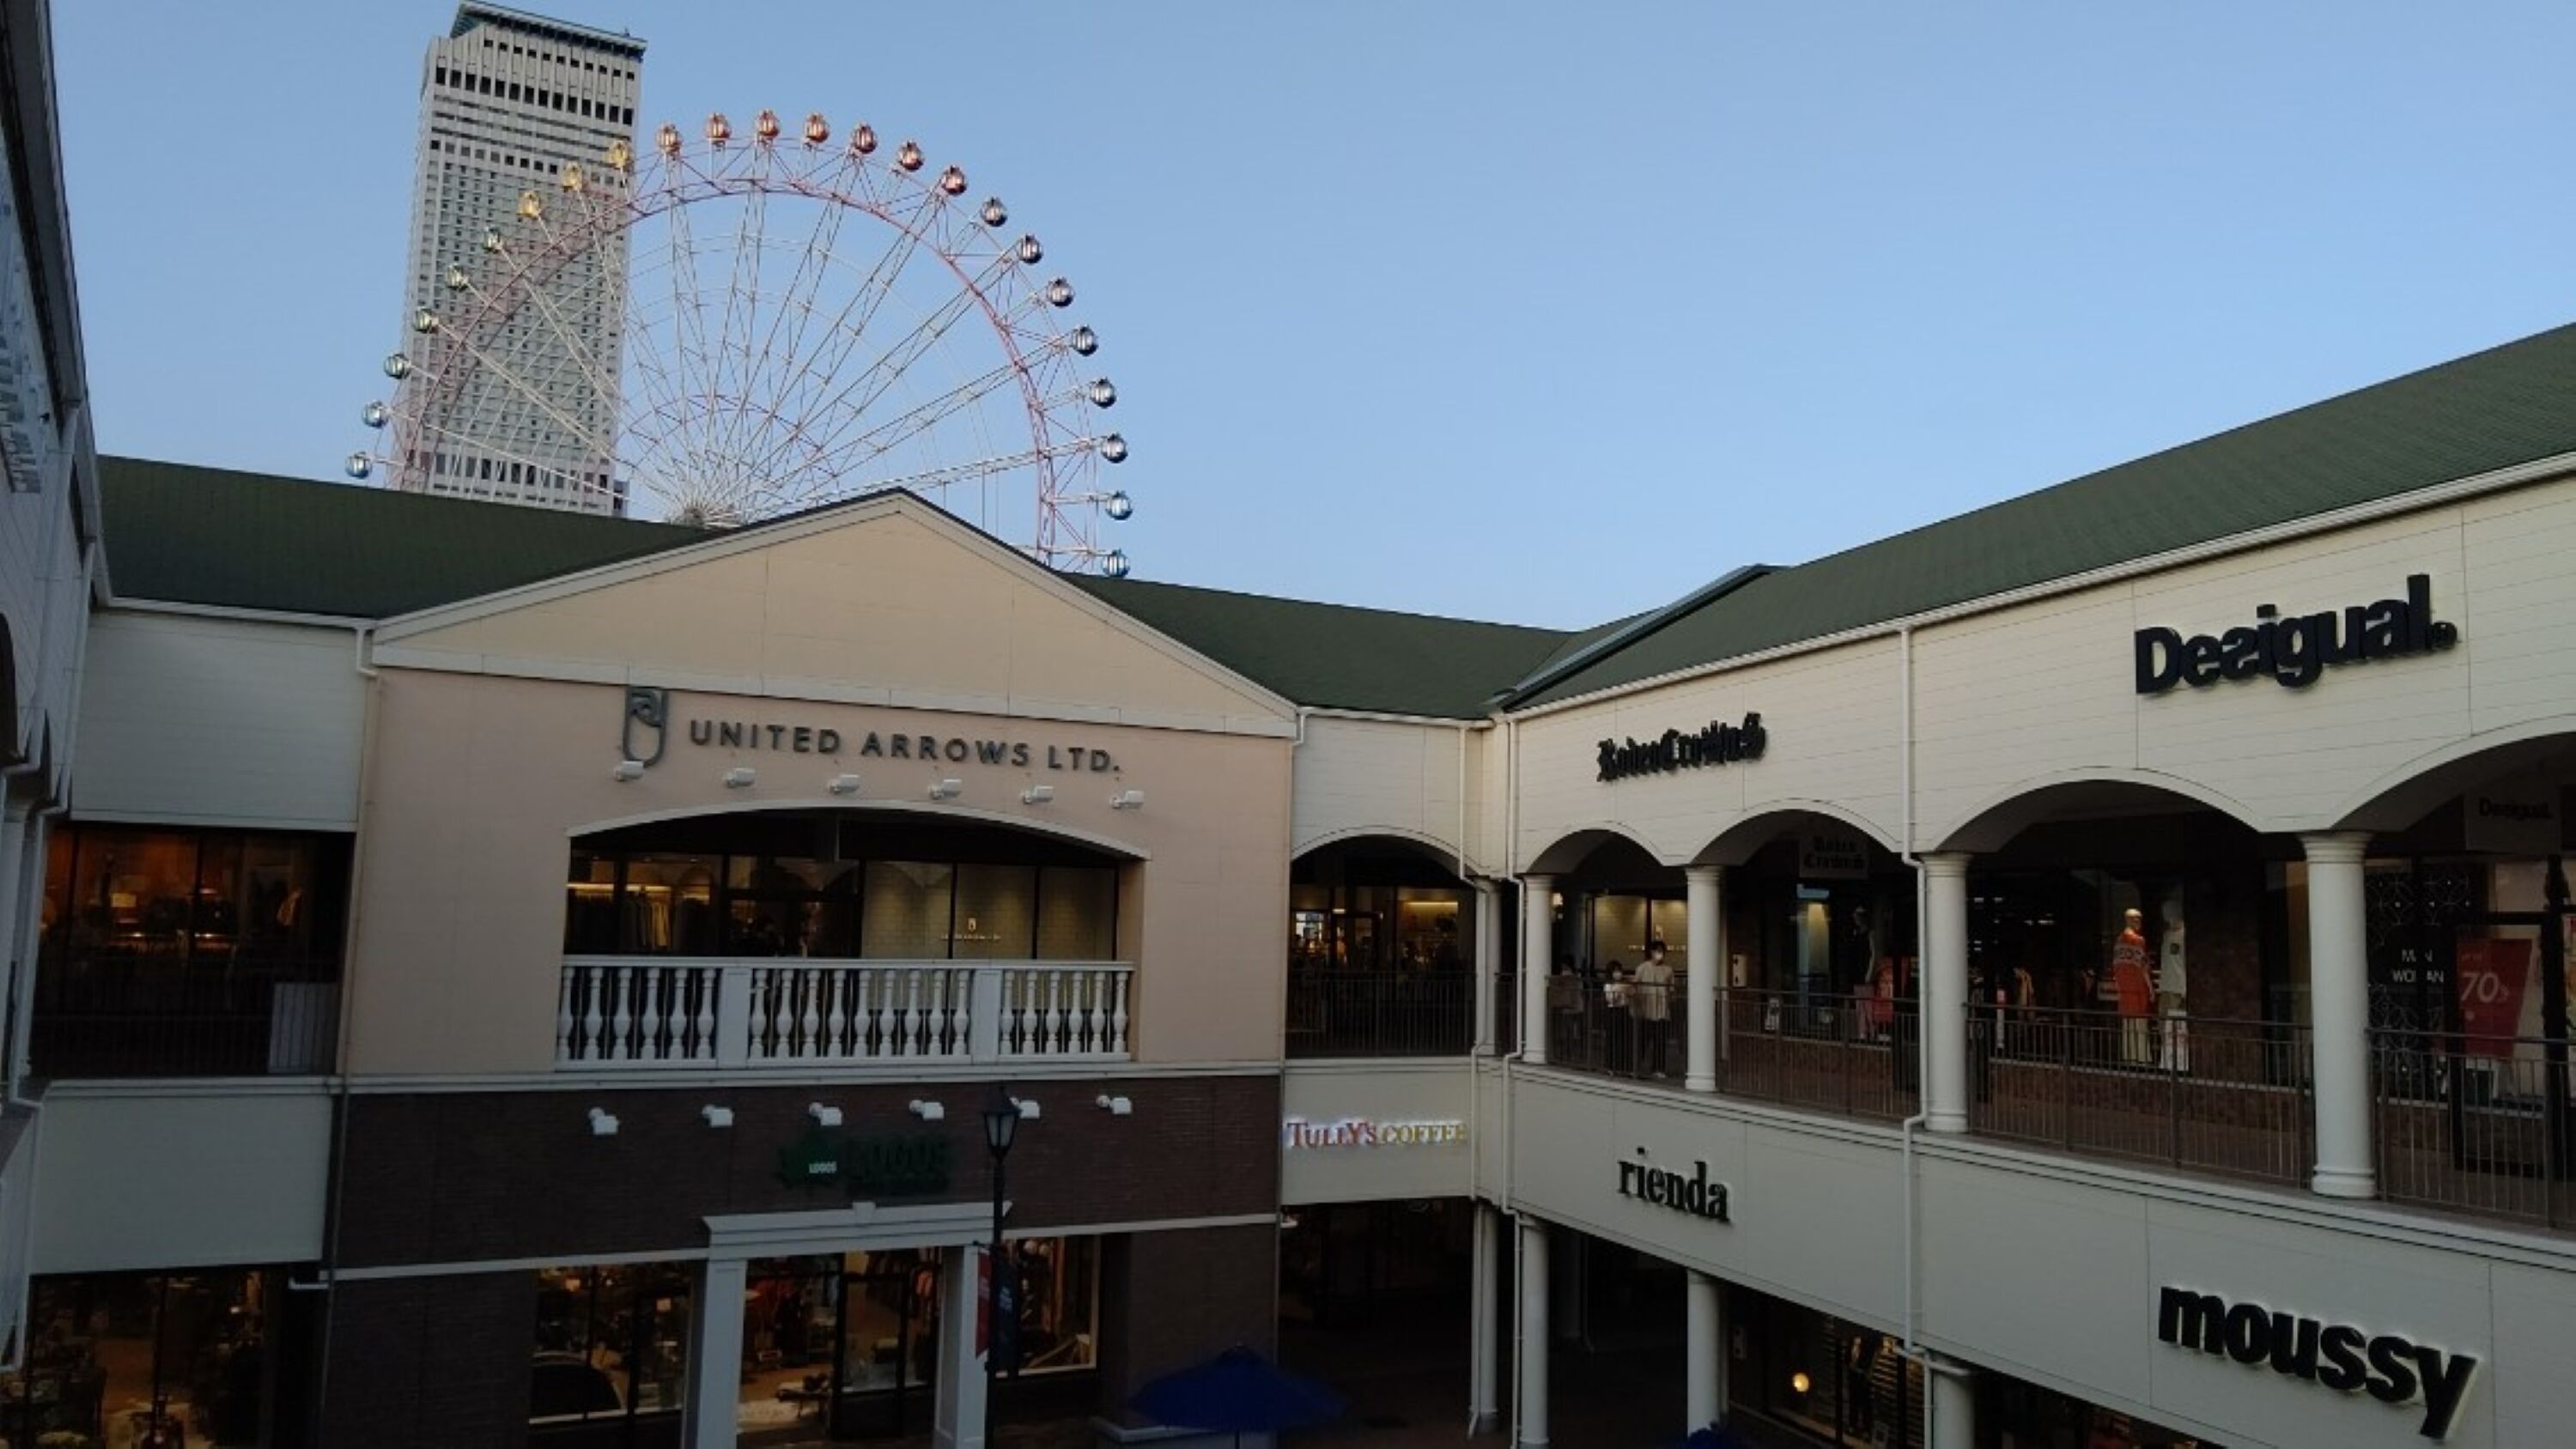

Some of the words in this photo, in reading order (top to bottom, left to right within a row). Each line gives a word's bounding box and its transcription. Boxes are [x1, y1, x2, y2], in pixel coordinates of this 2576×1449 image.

[690, 719, 841, 753] UNITED
[860, 731, 1029, 767] ARROWS
[1048, 744, 1120, 772] LTD.
[2391, 969, 2445, 983] WOAN
[2401, 949, 2433, 962] MN
[1618, 1147, 1730, 1222] rienda
[2158, 1285, 2476, 1440] moussy
